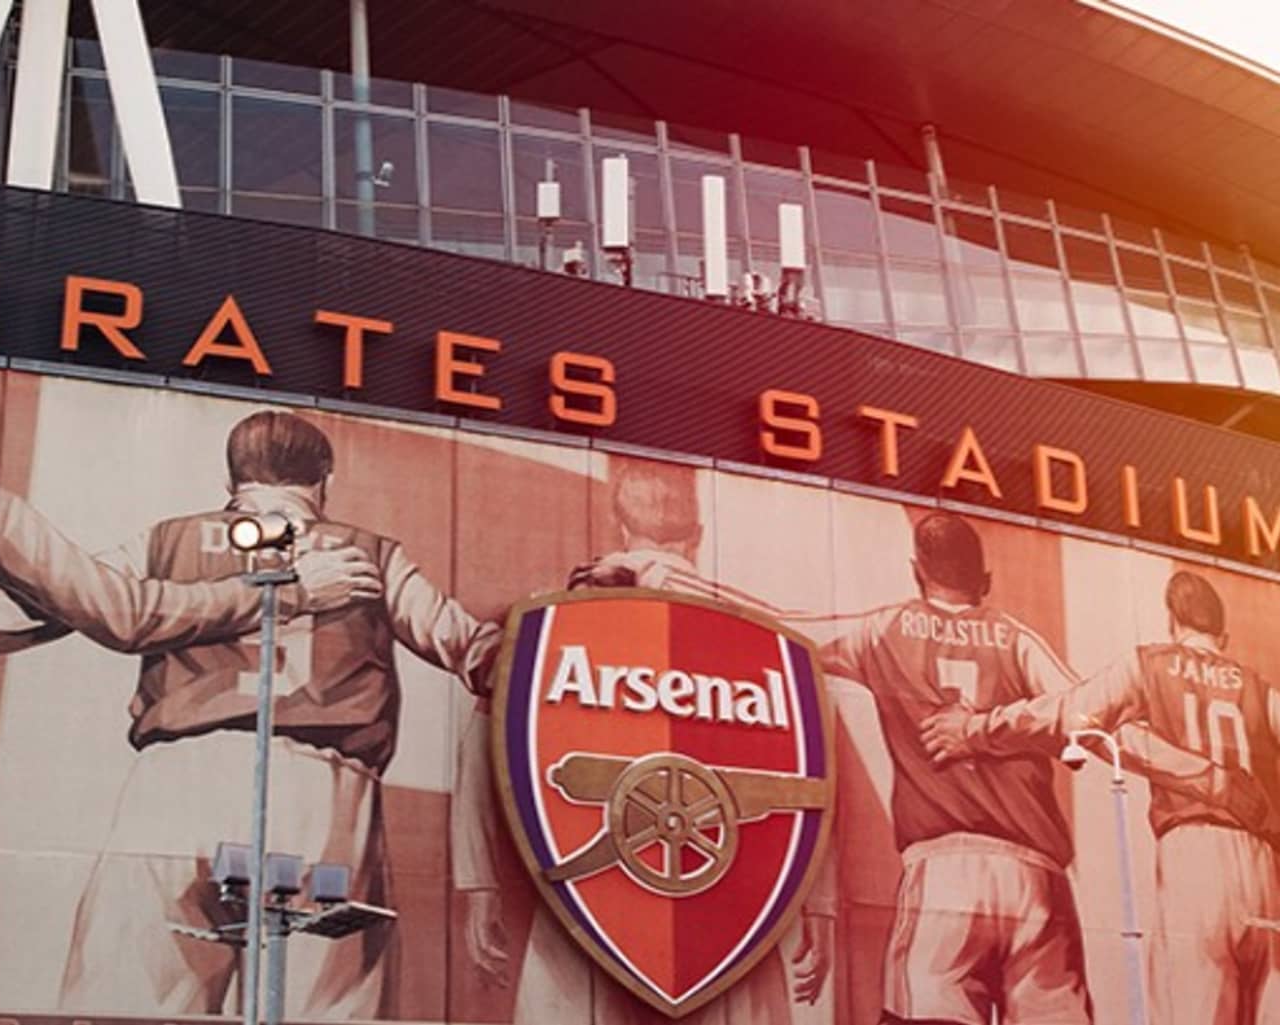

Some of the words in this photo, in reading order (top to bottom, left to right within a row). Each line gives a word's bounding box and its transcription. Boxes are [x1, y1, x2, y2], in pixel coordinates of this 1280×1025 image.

[900, 609, 1010, 649] ROCASTLE
[545, 645, 789, 728] Arsenal
[1167, 654, 1243, 690] JAMES
